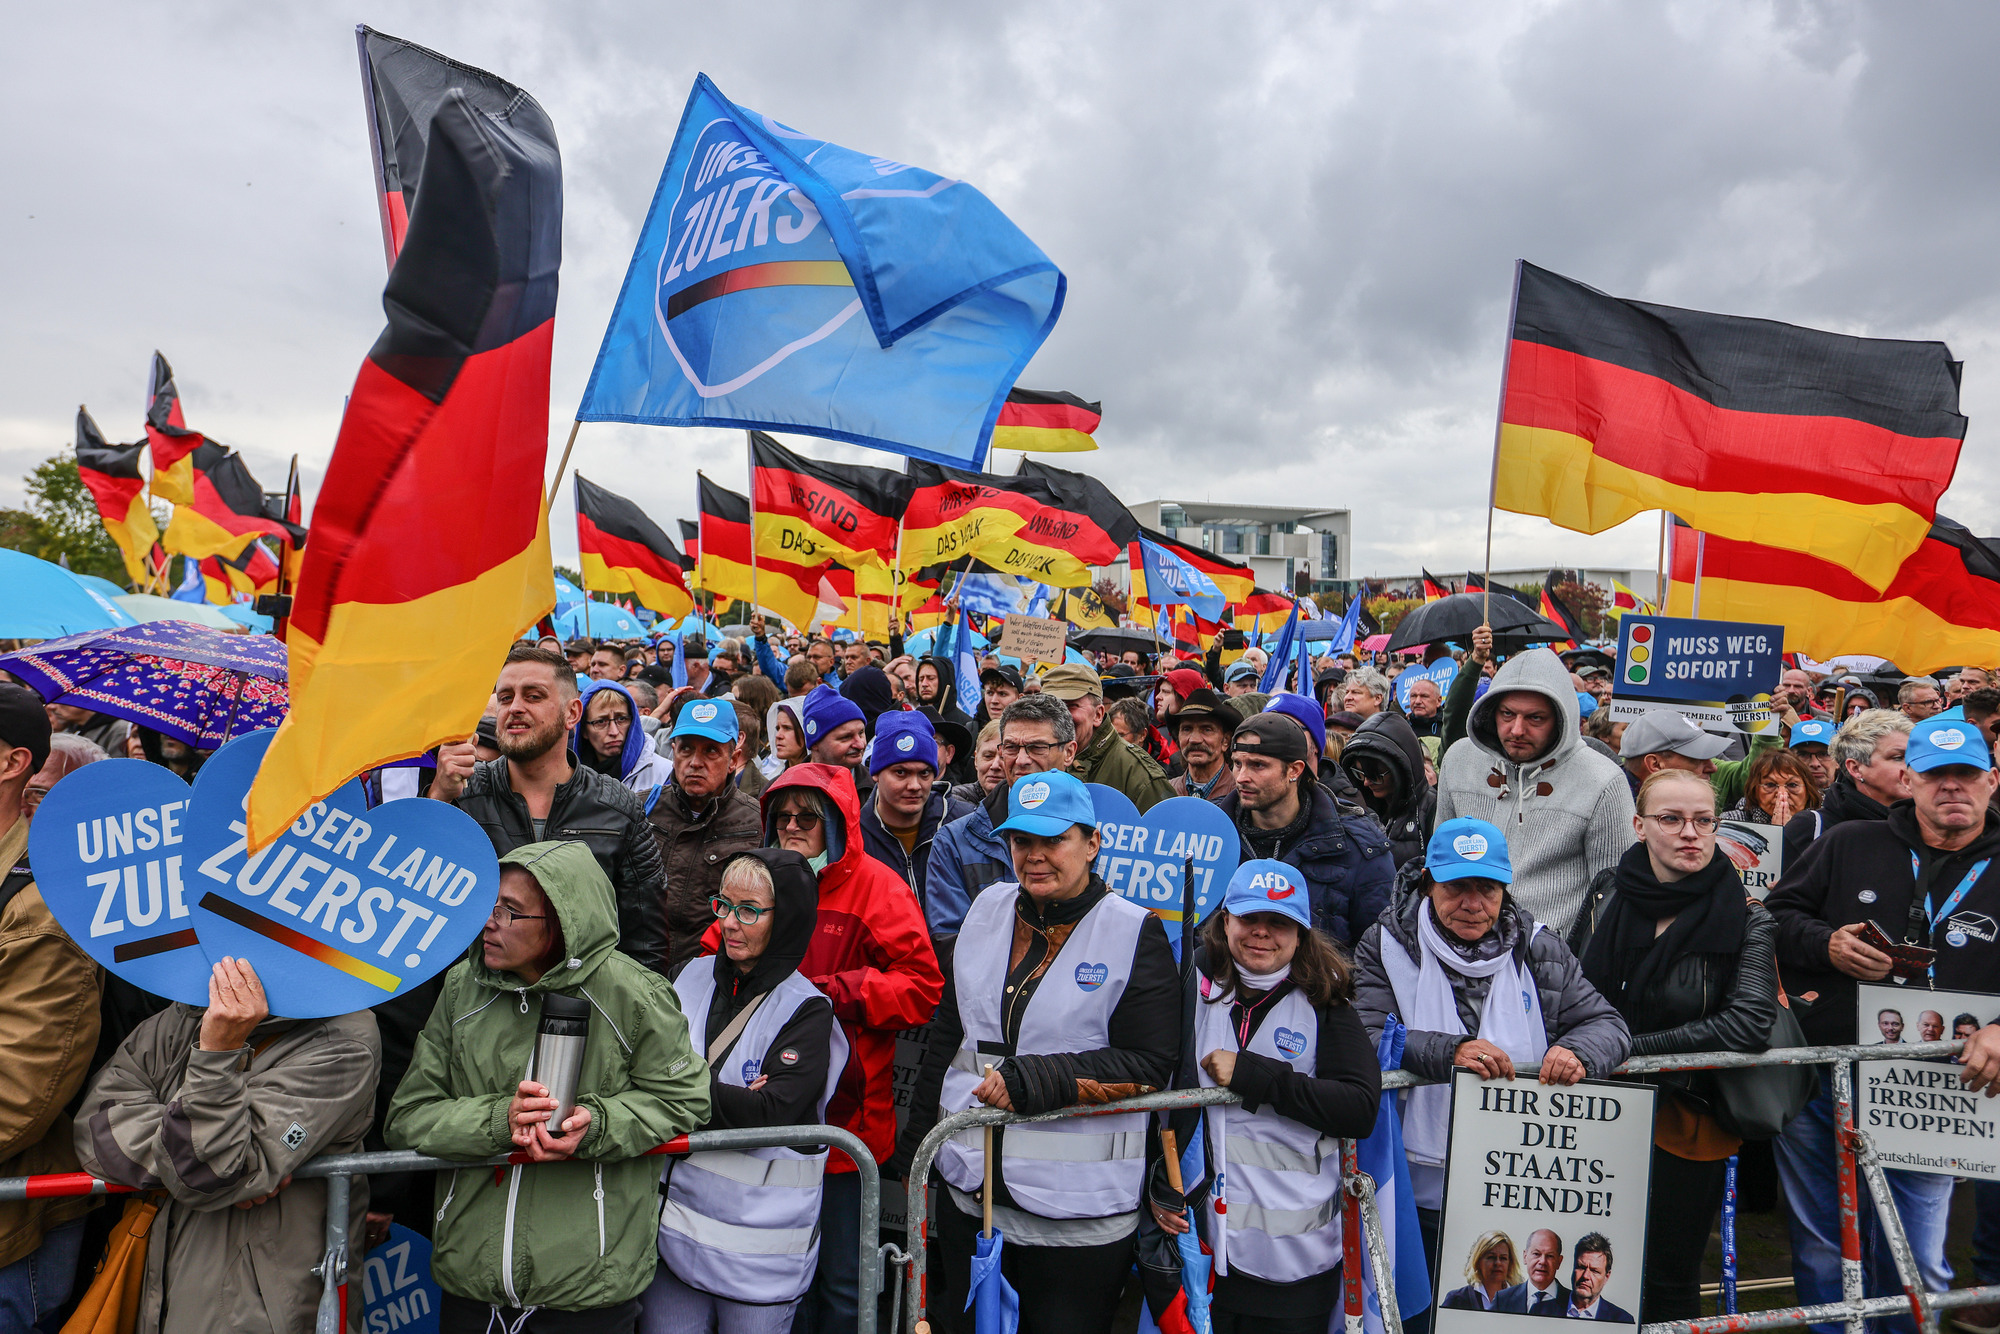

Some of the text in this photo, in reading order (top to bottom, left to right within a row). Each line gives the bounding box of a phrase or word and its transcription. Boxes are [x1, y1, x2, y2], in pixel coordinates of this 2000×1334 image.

[694, 141, 782, 192] UNS
[663, 177, 834, 287] ZUERS
[806, 491, 858, 533] SIND
[939, 493, 962, 513] WIR
[1028, 514, 1080, 540] WIR SIND
[937, 531, 957, 556] DAS
[1004, 548, 1027, 568] DAS
[1009, 616, 1022, 626] Wer
[1667, 635, 1772, 656] MUSS WEG,
[1430, 667, 1453, 681] LAND
[1665, 660, 1741, 680] SOFORT
[1731, 701, 1770, 711] UNSER LAND
[1732, 711, 1771, 723] ZUERST!
[77, 799, 191, 863] UNSE
[1096, 821, 1224, 862] SER LAND
[367, 834, 477, 907] LAND
[1096, 855, 1215, 906] ERST!
[1249, 871, 1289, 891] AfD
[1737, 869, 1775, 888] ER!
[197, 819, 449, 969] ZUERST!
[1947, 924, 1991, 942] DACHBAU
[1076, 973, 1104, 983] ZUERST!
[1276, 1037, 1303, 1053] ZUERST!
[1478, 1086, 1622, 1122] IHR SEID
[1868, 1086, 1979, 1115] IRRSINN
[1520, 1121, 1578, 1150] DIE
[1868, 1108, 1994, 1139] STOPPEN!
[1484, 1150, 1615, 1185] STAATS-
[1876, 1151, 1996, 1174] eutschland Kurier
[1482, 1182, 1613, 1217] FEINDE!
